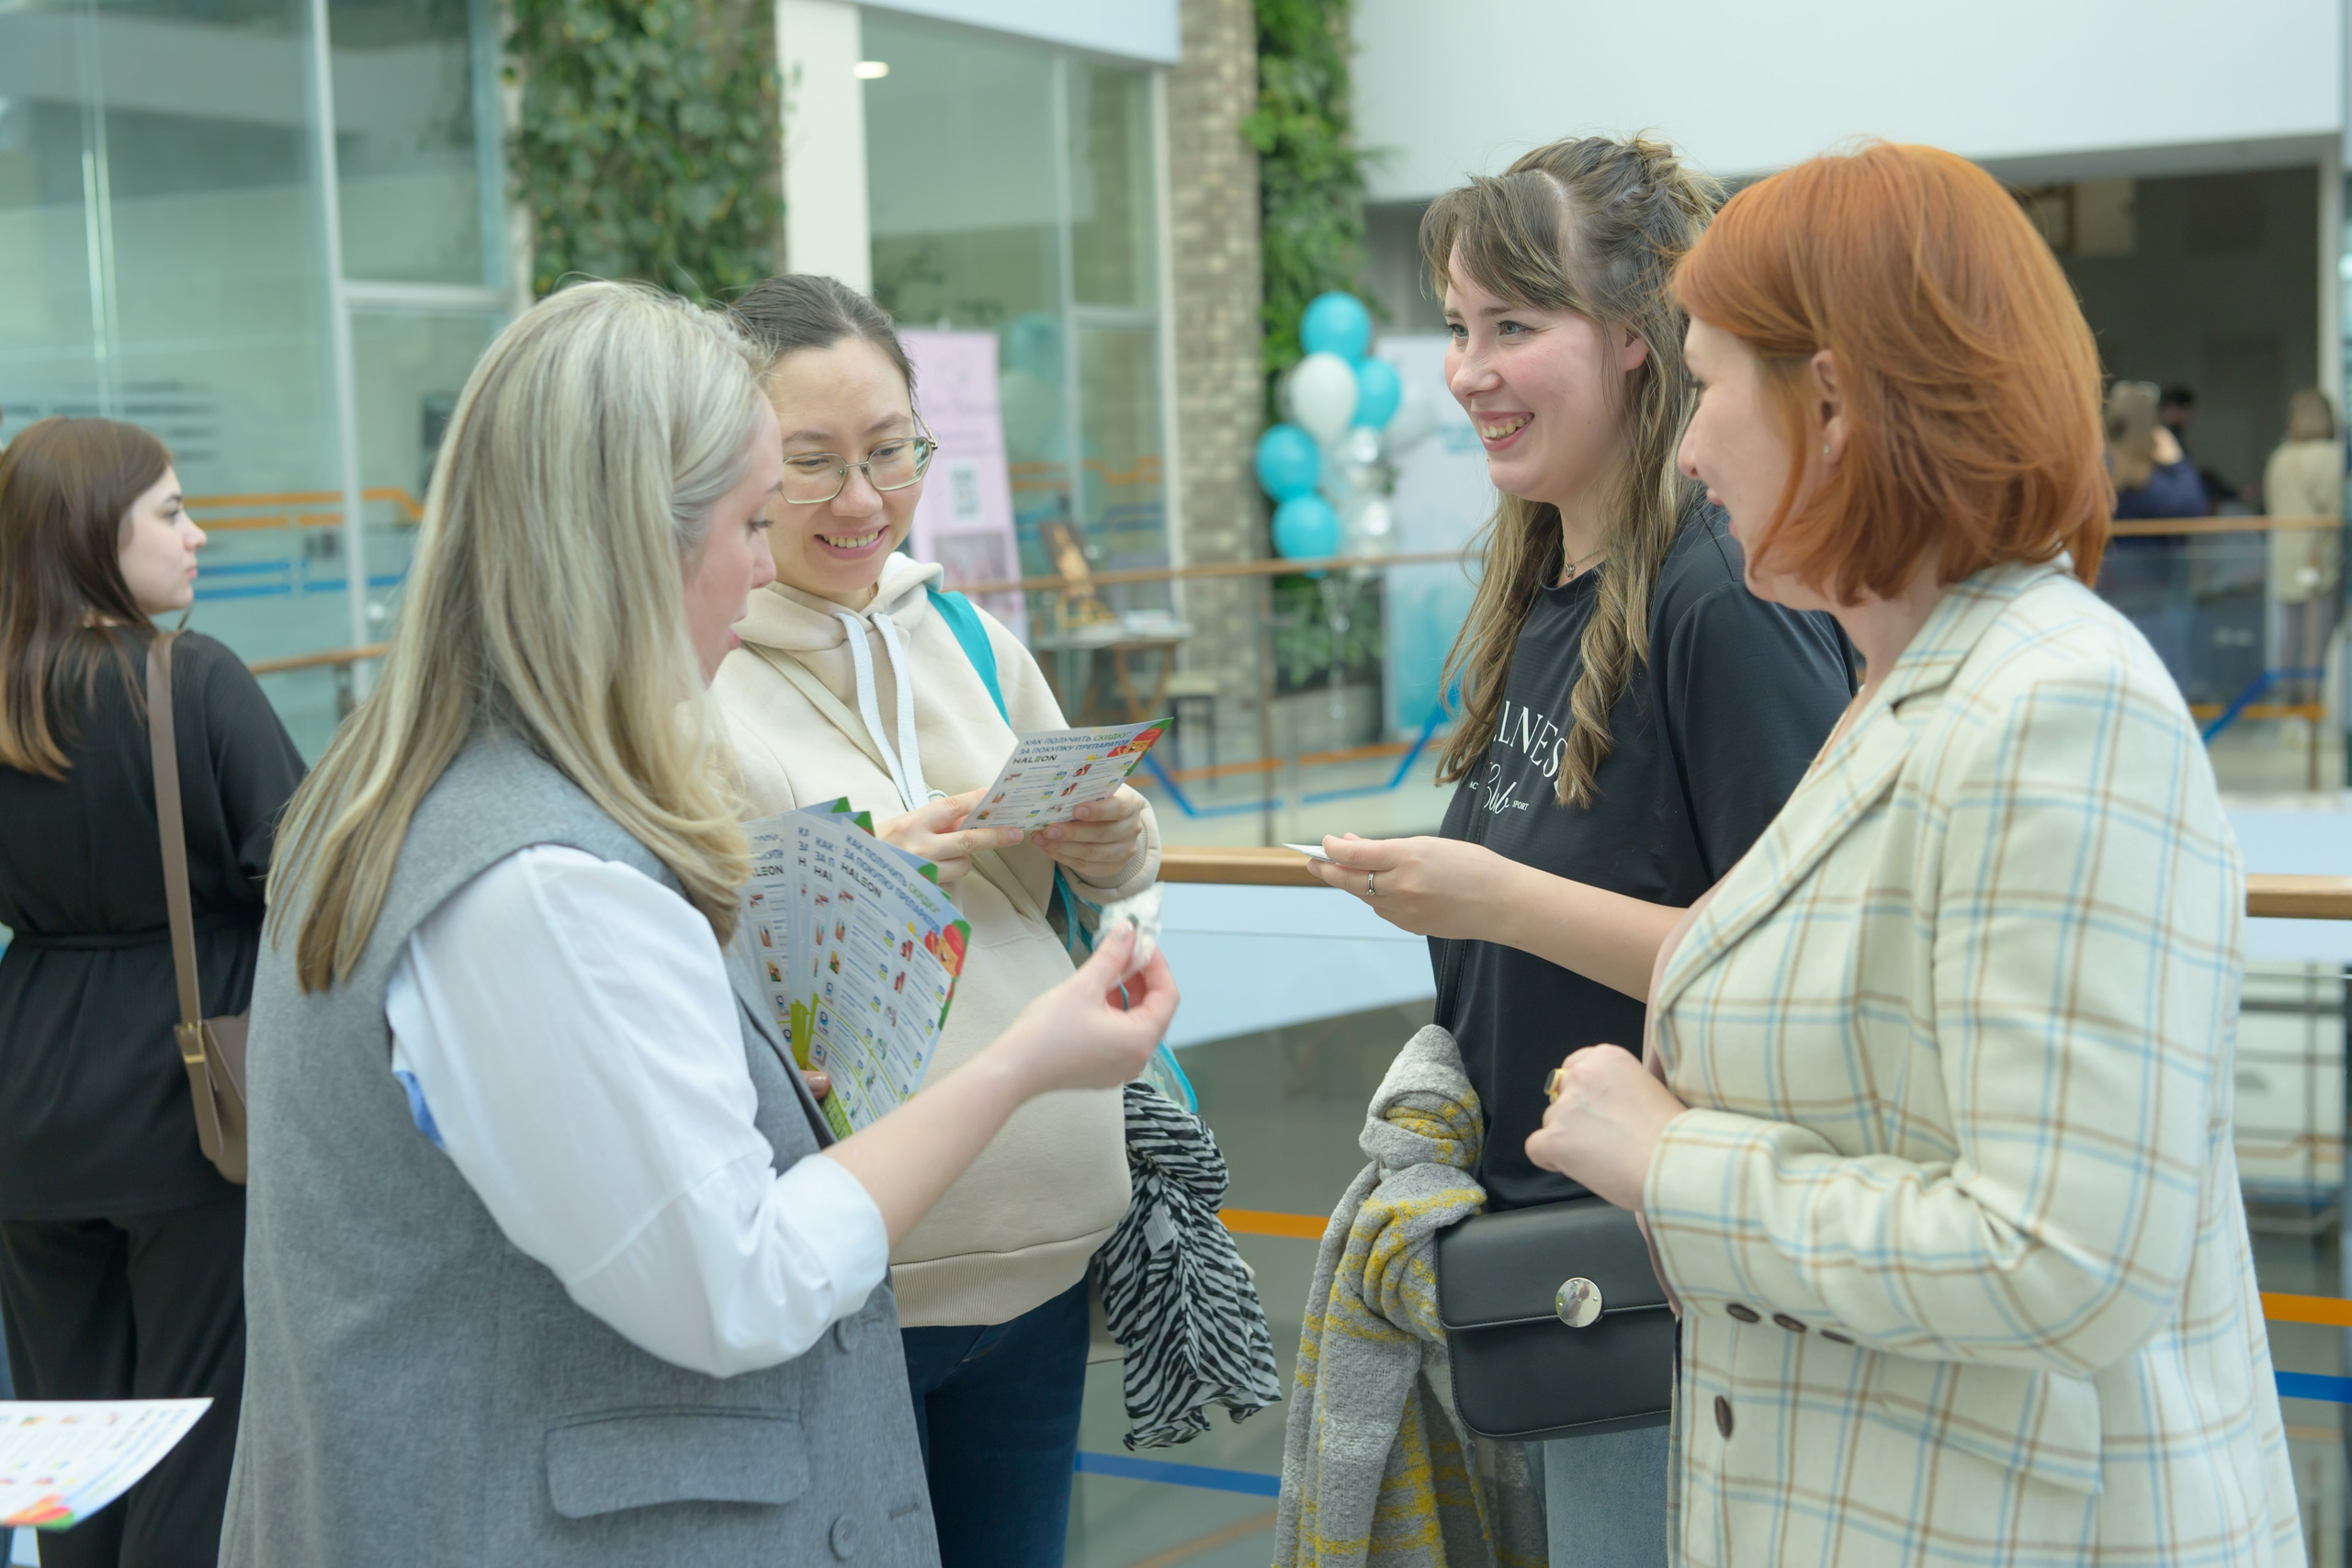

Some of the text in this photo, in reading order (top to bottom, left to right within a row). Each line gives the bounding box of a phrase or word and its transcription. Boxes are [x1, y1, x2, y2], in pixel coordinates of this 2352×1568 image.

[1075, 739, 1130, 750] ПРЕПАРАТОВ
[1012, 755, 1057, 765] HALEON
[1511, 799, 1529, 811] SPORT
[752, 864, 785, 877] LEON
[841, 862, 882, 898] HALEON
